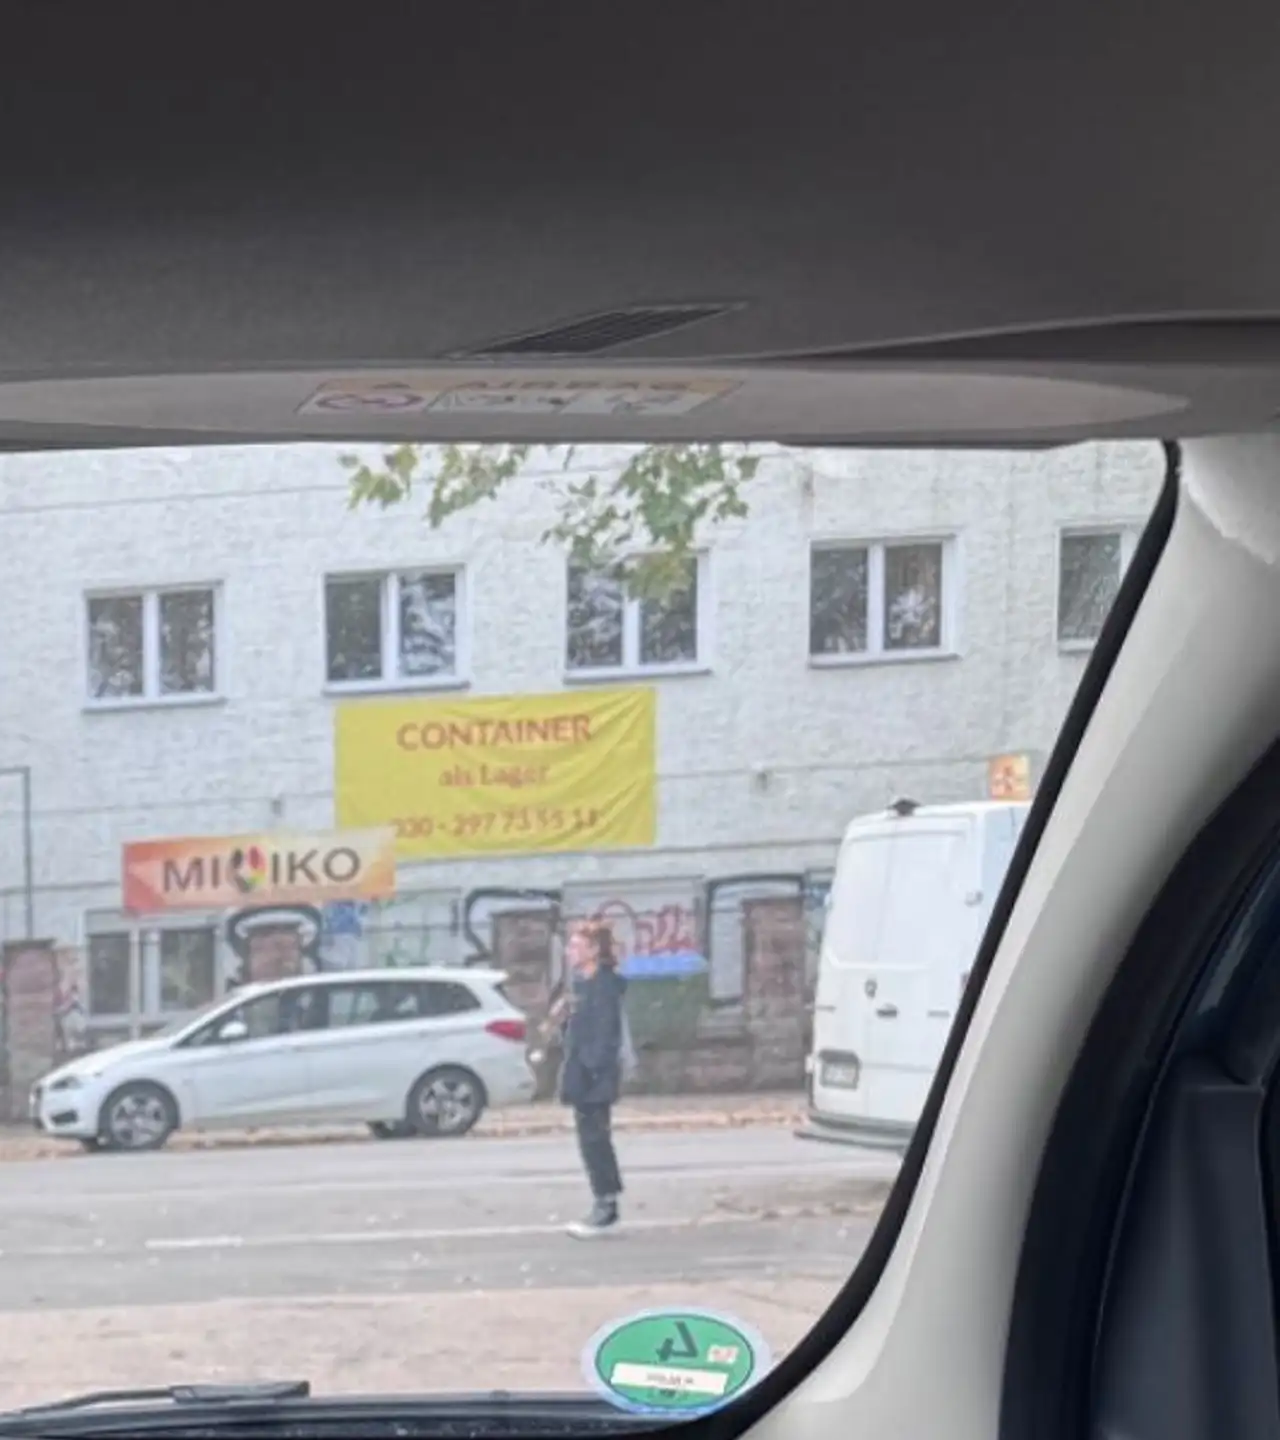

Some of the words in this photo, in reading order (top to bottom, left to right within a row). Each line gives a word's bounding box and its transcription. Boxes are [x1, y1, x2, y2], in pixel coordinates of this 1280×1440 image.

[396, 714, 593, 751] CONTAINER
[439, 765, 473, 788] als
[480, 764, 551, 789] Lager
